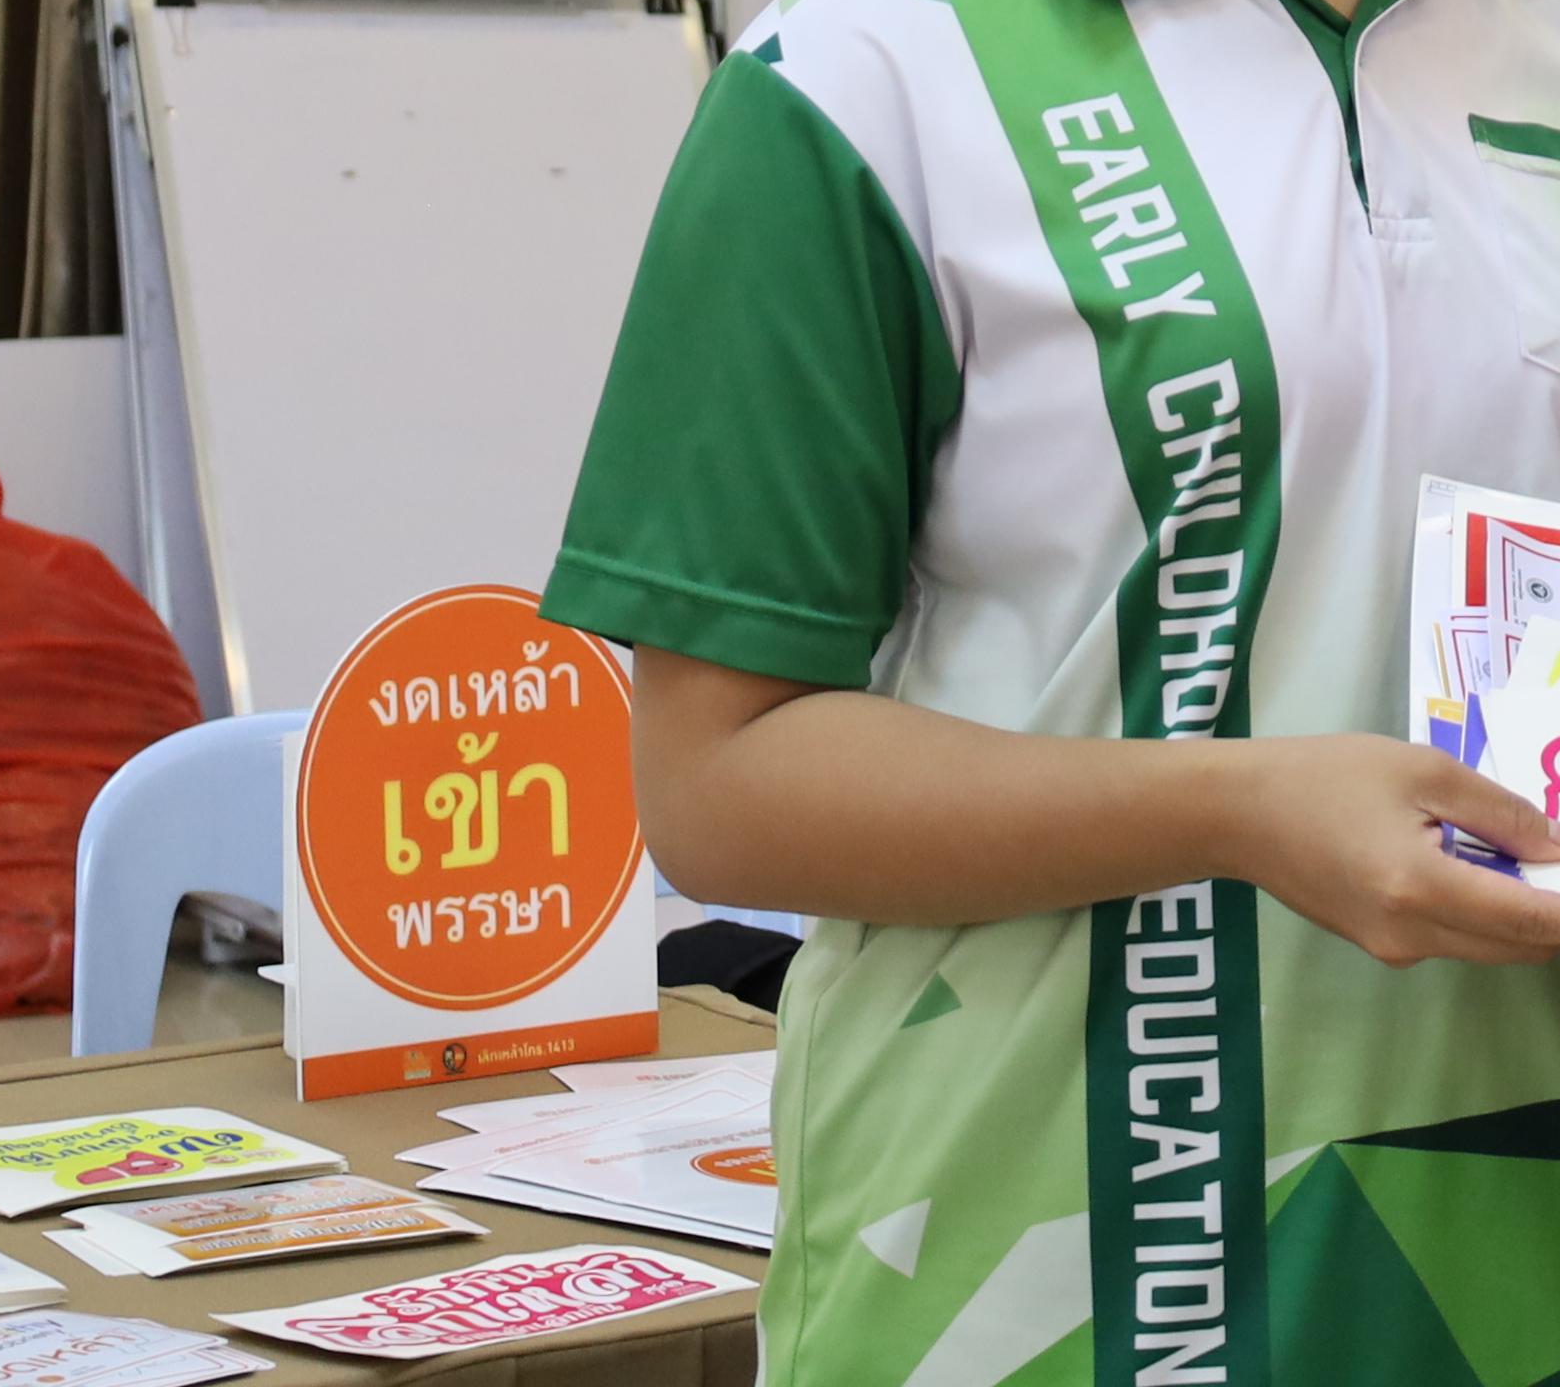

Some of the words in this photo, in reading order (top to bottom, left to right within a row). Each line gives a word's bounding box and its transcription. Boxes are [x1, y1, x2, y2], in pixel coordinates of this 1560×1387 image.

[1041, 93, 1218, 322] EARLY
[1146, 358, 1244, 740] CHILDHO
[368, 640, 581, 727] งดเหล้า
[383, 731, 569, 876] เข้า
[387, 883, 571, 949] พรรษา
[547, 1038, 575, 1054] 1413
[1125, 878, 1227, 1387] EDUCATION
[294, 1253, 674, 1348] เลิกเหล้า
[386, 1263, 544, 1315] รักกัน
